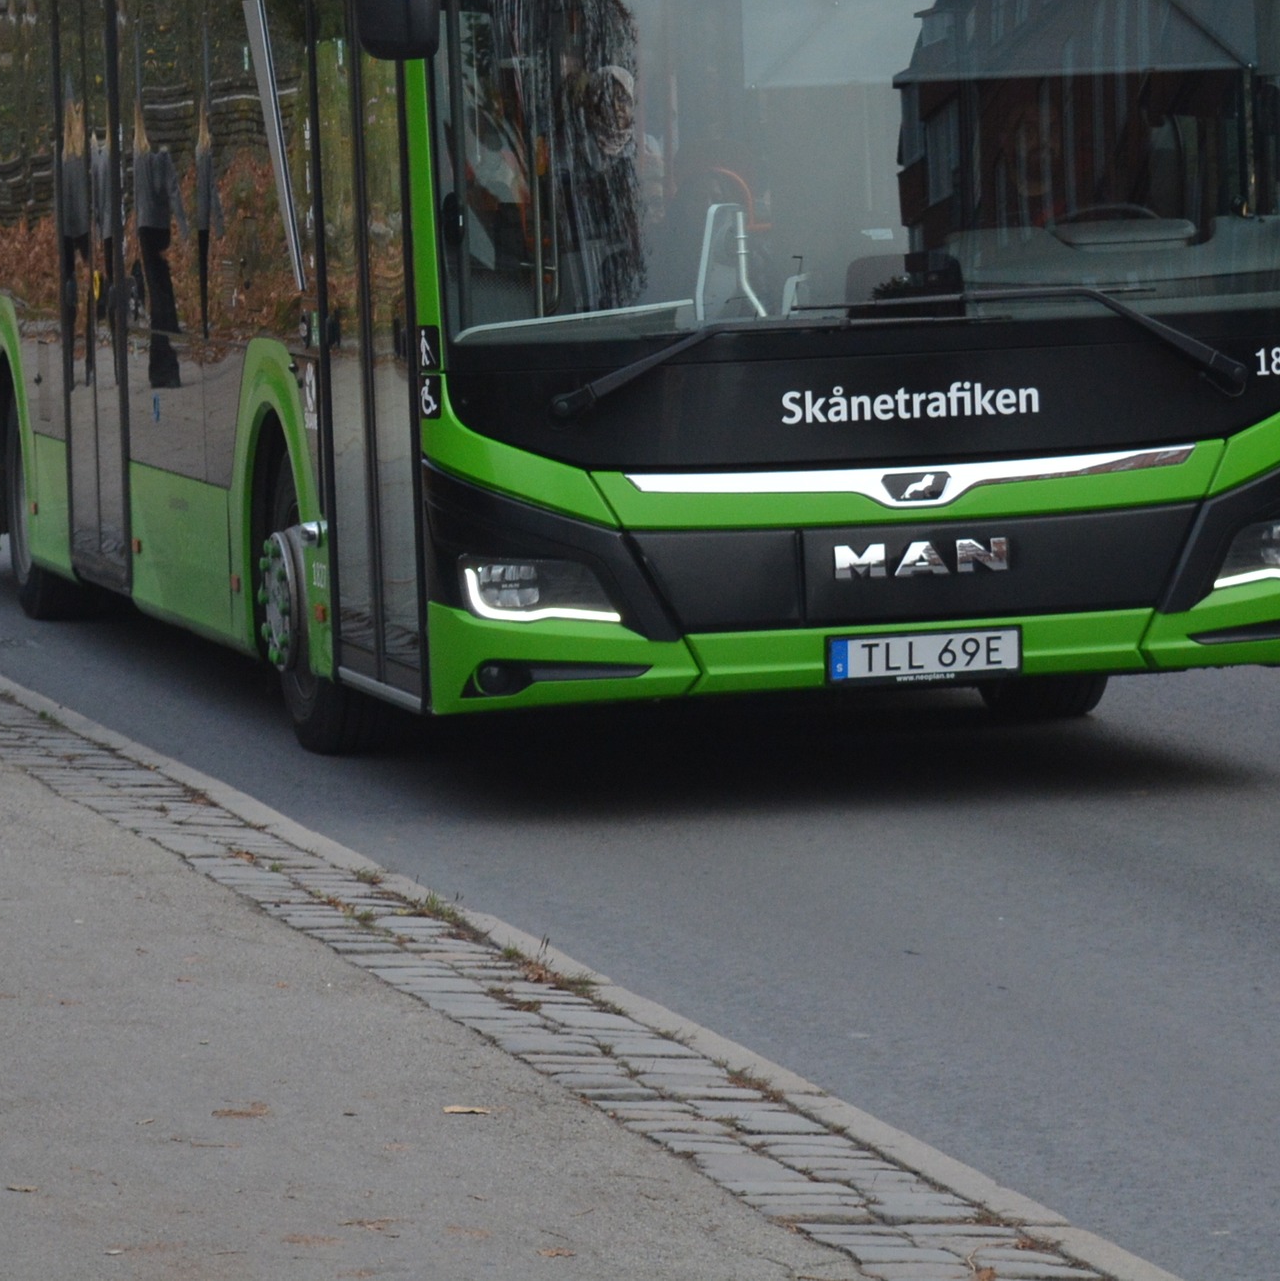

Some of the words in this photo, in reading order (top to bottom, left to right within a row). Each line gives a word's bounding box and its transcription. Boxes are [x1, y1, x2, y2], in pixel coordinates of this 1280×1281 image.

[781, 379, 1040, 425] Skånetrafiken
[833, 536, 1009, 580] MAN
[836, 663, 843, 672] S
[861, 641, 924, 672] TLL
[938, 636, 1002, 667] 69E
[896, 672, 955, 682] www.neoplan.se
